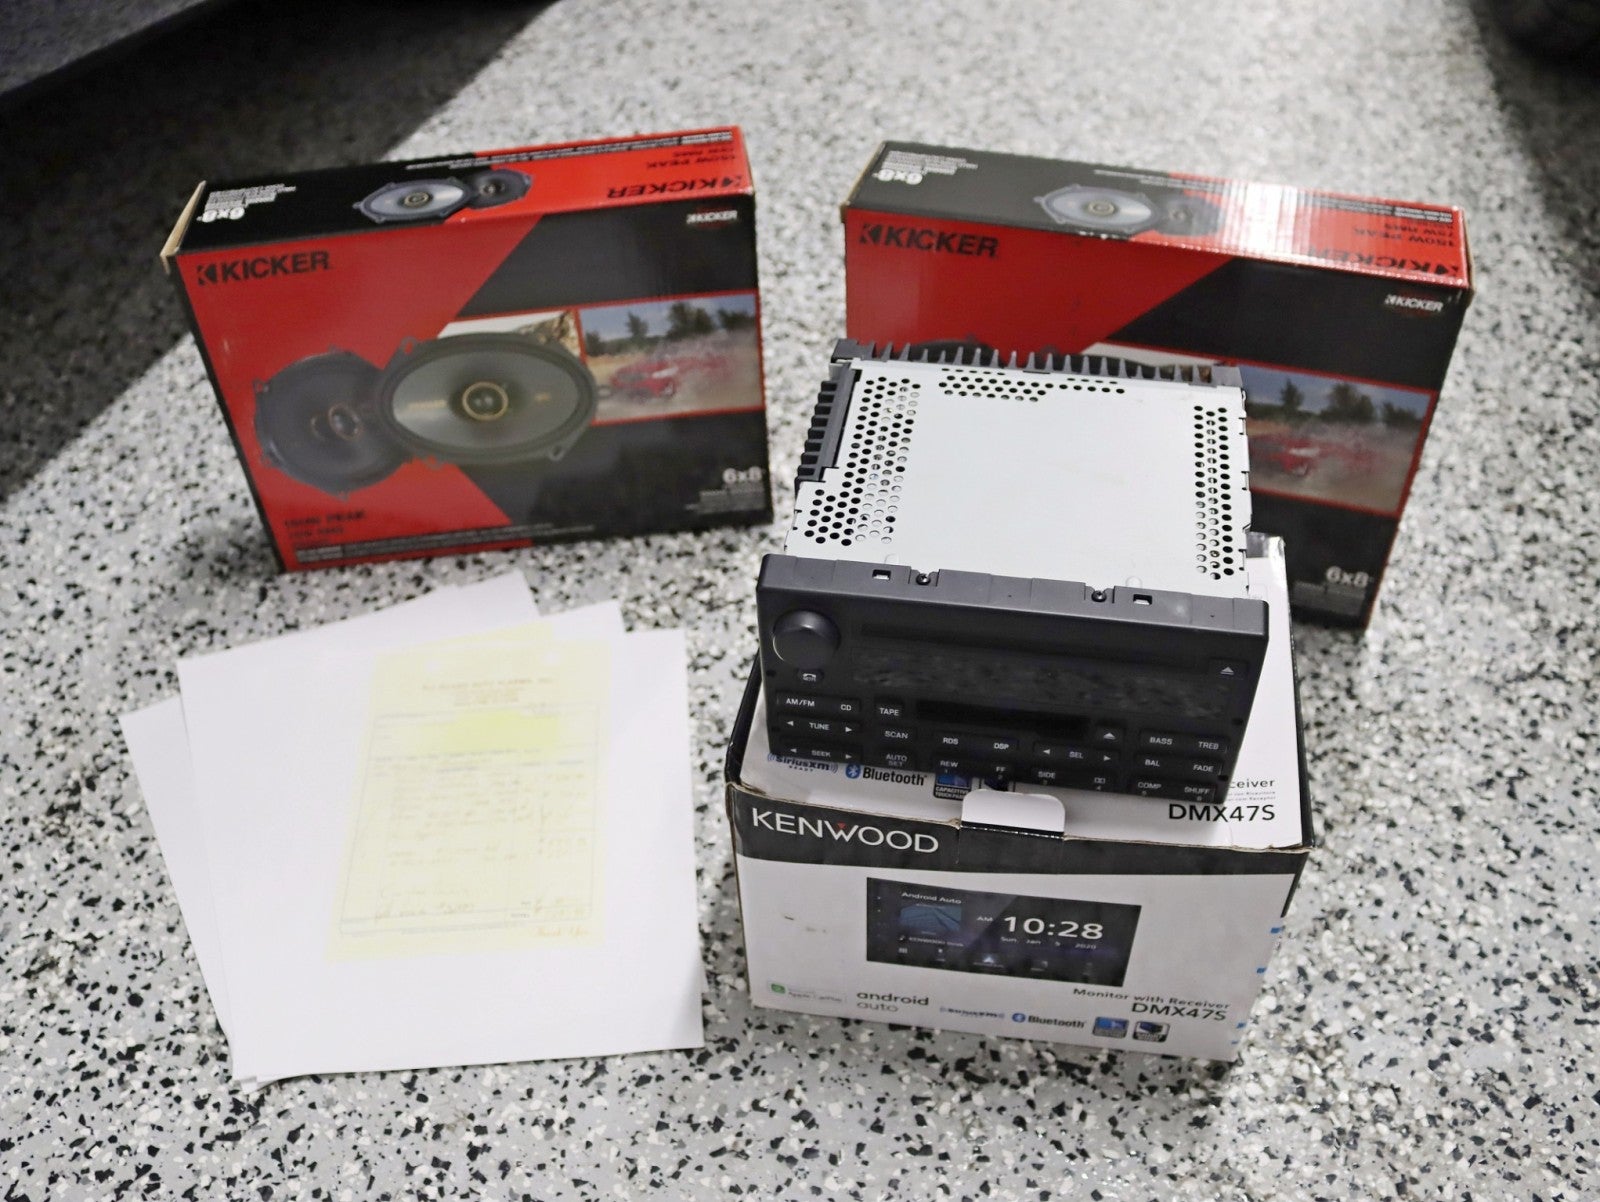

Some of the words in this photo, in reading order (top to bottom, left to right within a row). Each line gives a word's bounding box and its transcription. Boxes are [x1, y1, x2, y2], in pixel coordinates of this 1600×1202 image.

[607, 177, 717, 199] KICKER
[884, 225, 1000, 258] KICKER
[221, 251, 330, 285] KICKER
[1398, 295, 1444, 312] KICKER
[785, 698, 815, 707] AM/FM
[879, 707, 900, 716] TAPE
[809, 722, 830, 731] TUNE
[884, 730, 908, 740] SCAN
[942, 737, 959, 745] RDS
[993, 742, 1010, 751] DSP
[1149, 736, 1173, 746] BASS
[1198, 741, 1219, 750] TREB
[811, 750, 831, 758] SEEK
[885, 753, 908, 762] AUTO
[1069, 750, 1084, 760] SEL
[940, 760, 959, 768] REW
[1144, 758, 1161, 767] BAL
[1193, 764, 1214, 773] FADE
[862, 767, 926, 787] Bluetooth
[1037, 771, 1056, 779] SIDE
[1137, 781, 1162, 790] COMP
[1184, 786, 1211, 795] SHUFF
[1168, 803, 1276, 823] DMX47S
[752, 807, 940, 853] KENWOOD
[901, 891, 938, 902] Android
[939, 896, 962, 905] Auto
[1003, 915, 1104, 940] 10:28
[856, 991, 930, 1006] android
[1073, 987, 1129, 1001] Monitor
[1133, 995, 1164, 1004] with
[1169, 997, 1231, 1010] Receiver
[856, 1002, 899, 1013] auto
[1131, 1002, 1228, 1021] DMX47S
[1027, 1015, 1086, 1029] Bluetooth
